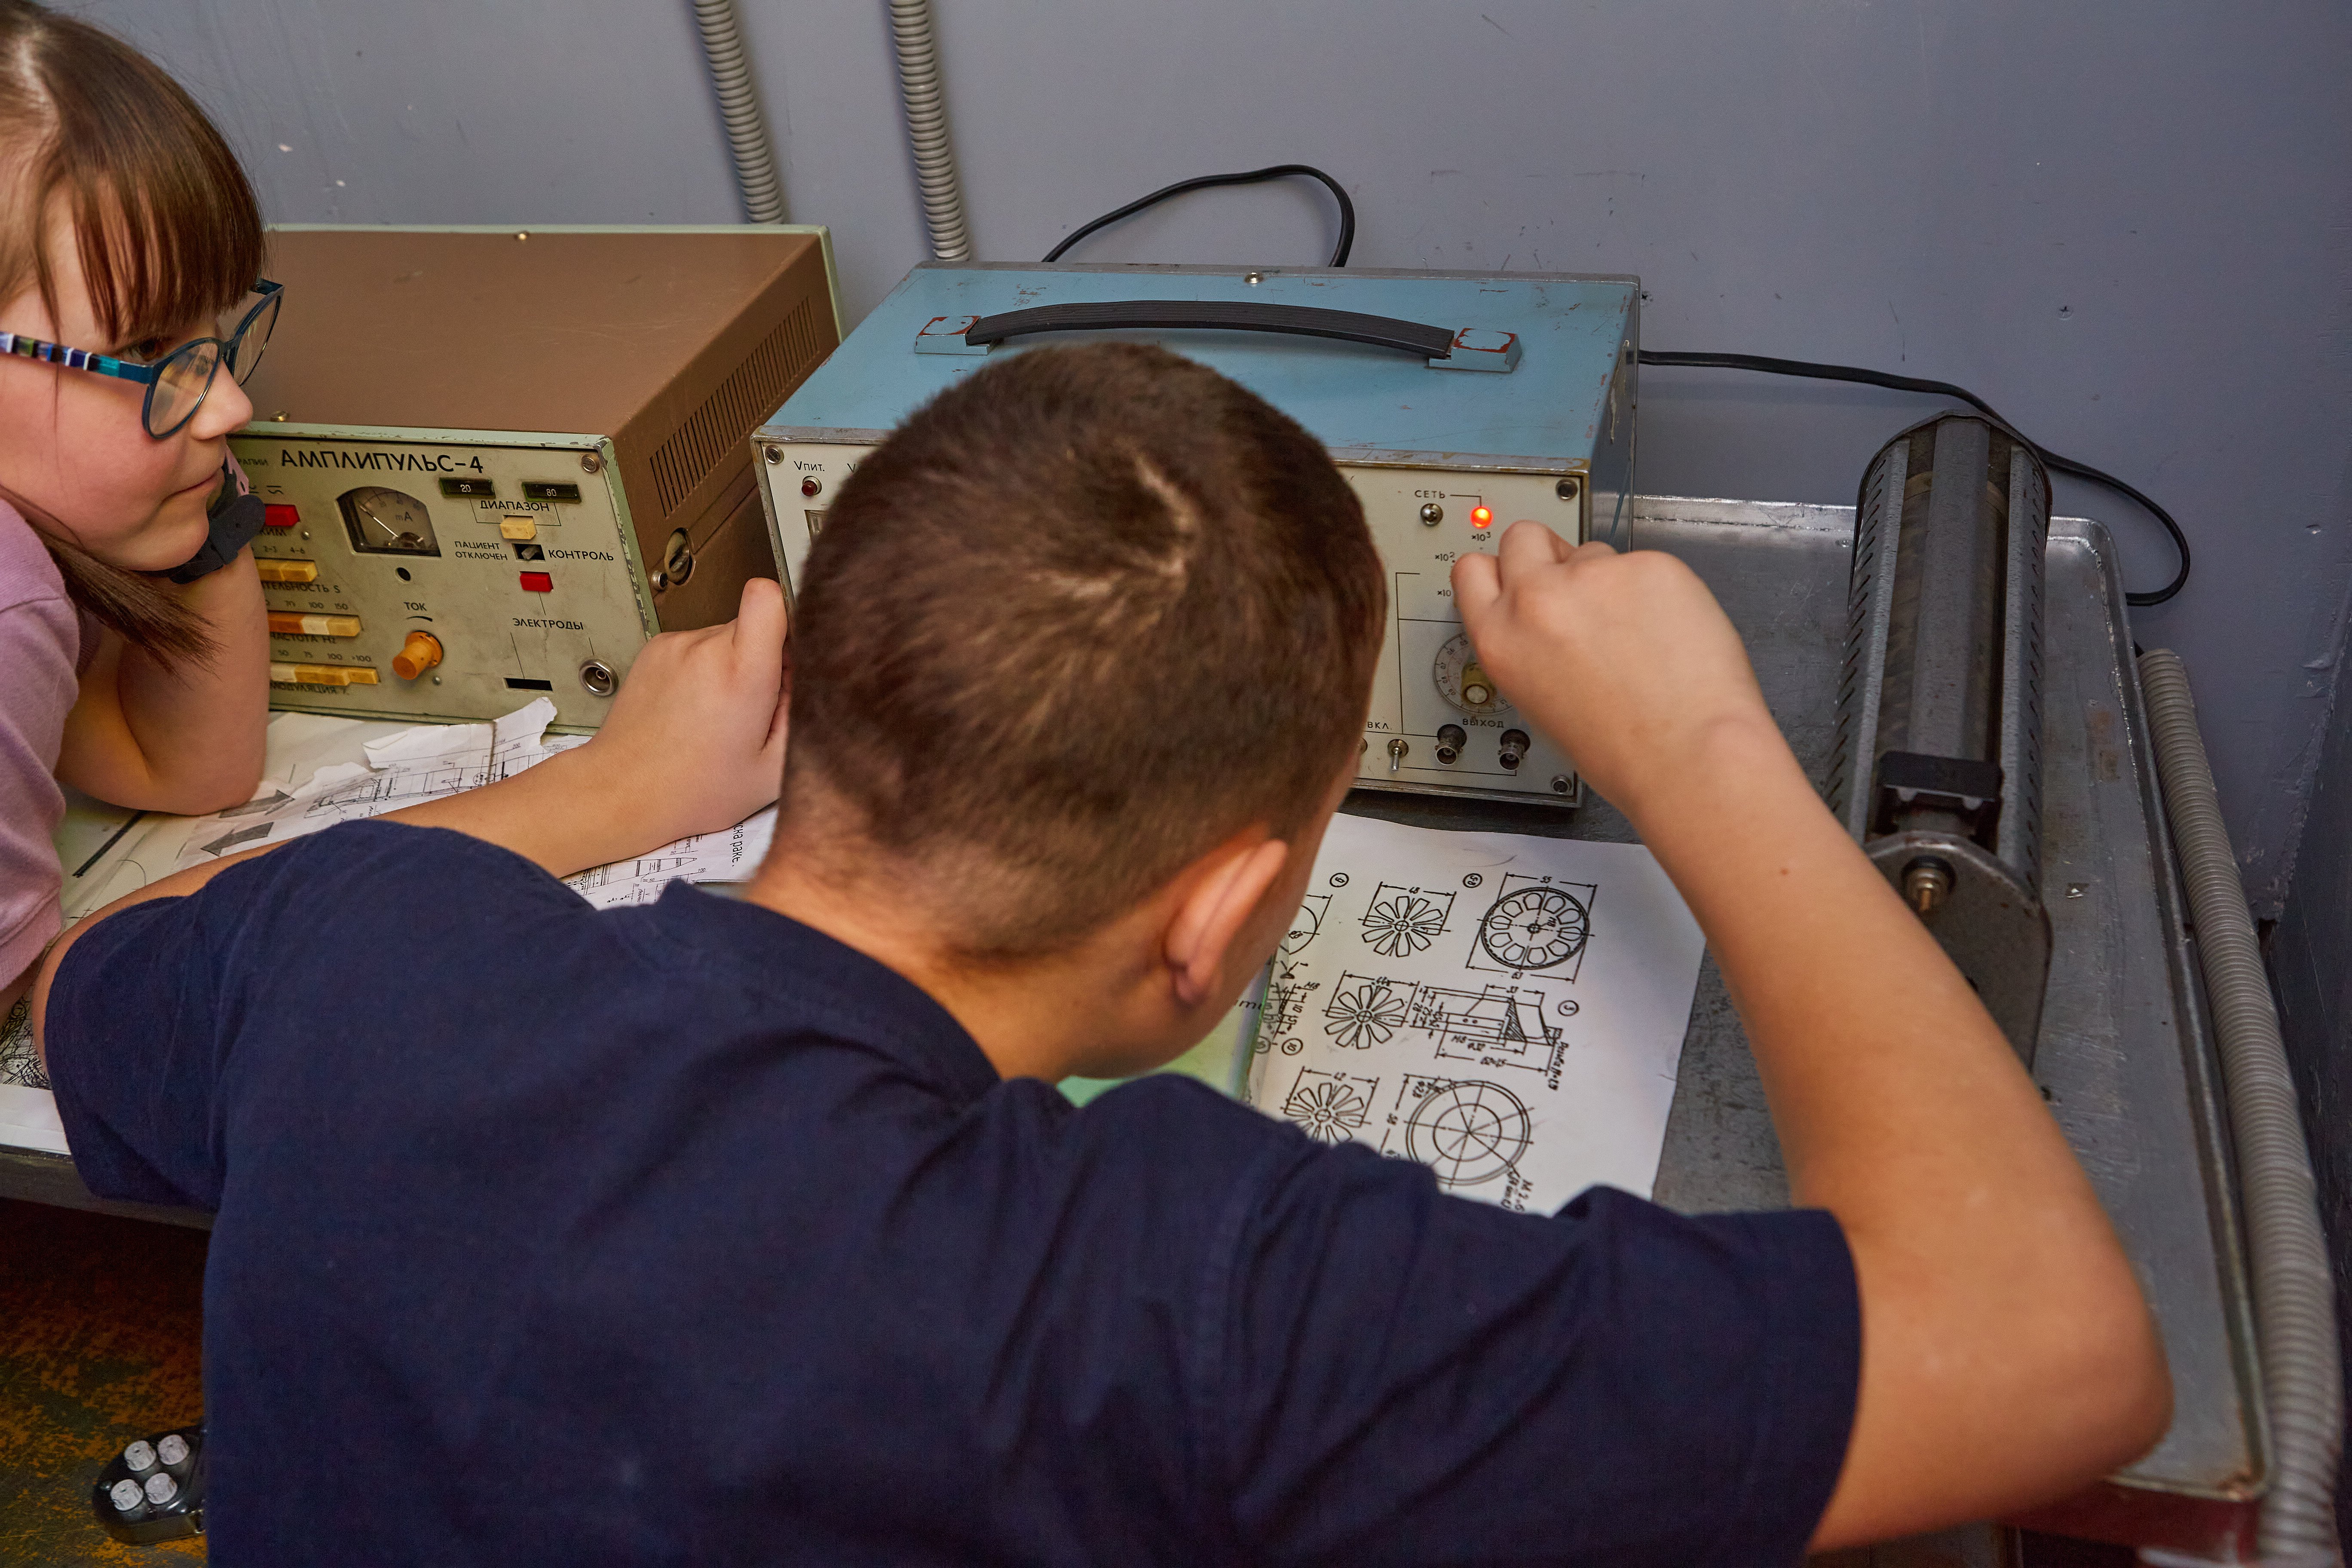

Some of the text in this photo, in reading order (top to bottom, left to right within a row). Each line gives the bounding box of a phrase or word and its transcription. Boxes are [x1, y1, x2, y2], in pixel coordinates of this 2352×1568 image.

[282, 449, 484, 473] АМПЛИПУЛЬС-4
[460, 484, 472, 493] 20
[546, 488, 557, 496] 80
[1414, 490, 1446, 499] СЕТЬ
[480, 500, 550, 511] ДИАПАЗОН
[454, 541, 500, 550] ПАЦИЕНТ
[455, 551, 508, 560] ОТКЛЮЧЕН
[548, 550, 614, 561] КОНТРОЛЬ
[404, 602, 427, 611] ТОК
[513, 618, 584, 630] ЭЛЕКТРОДЫ
[1463, 718, 1504, 728] ВЫХОД
